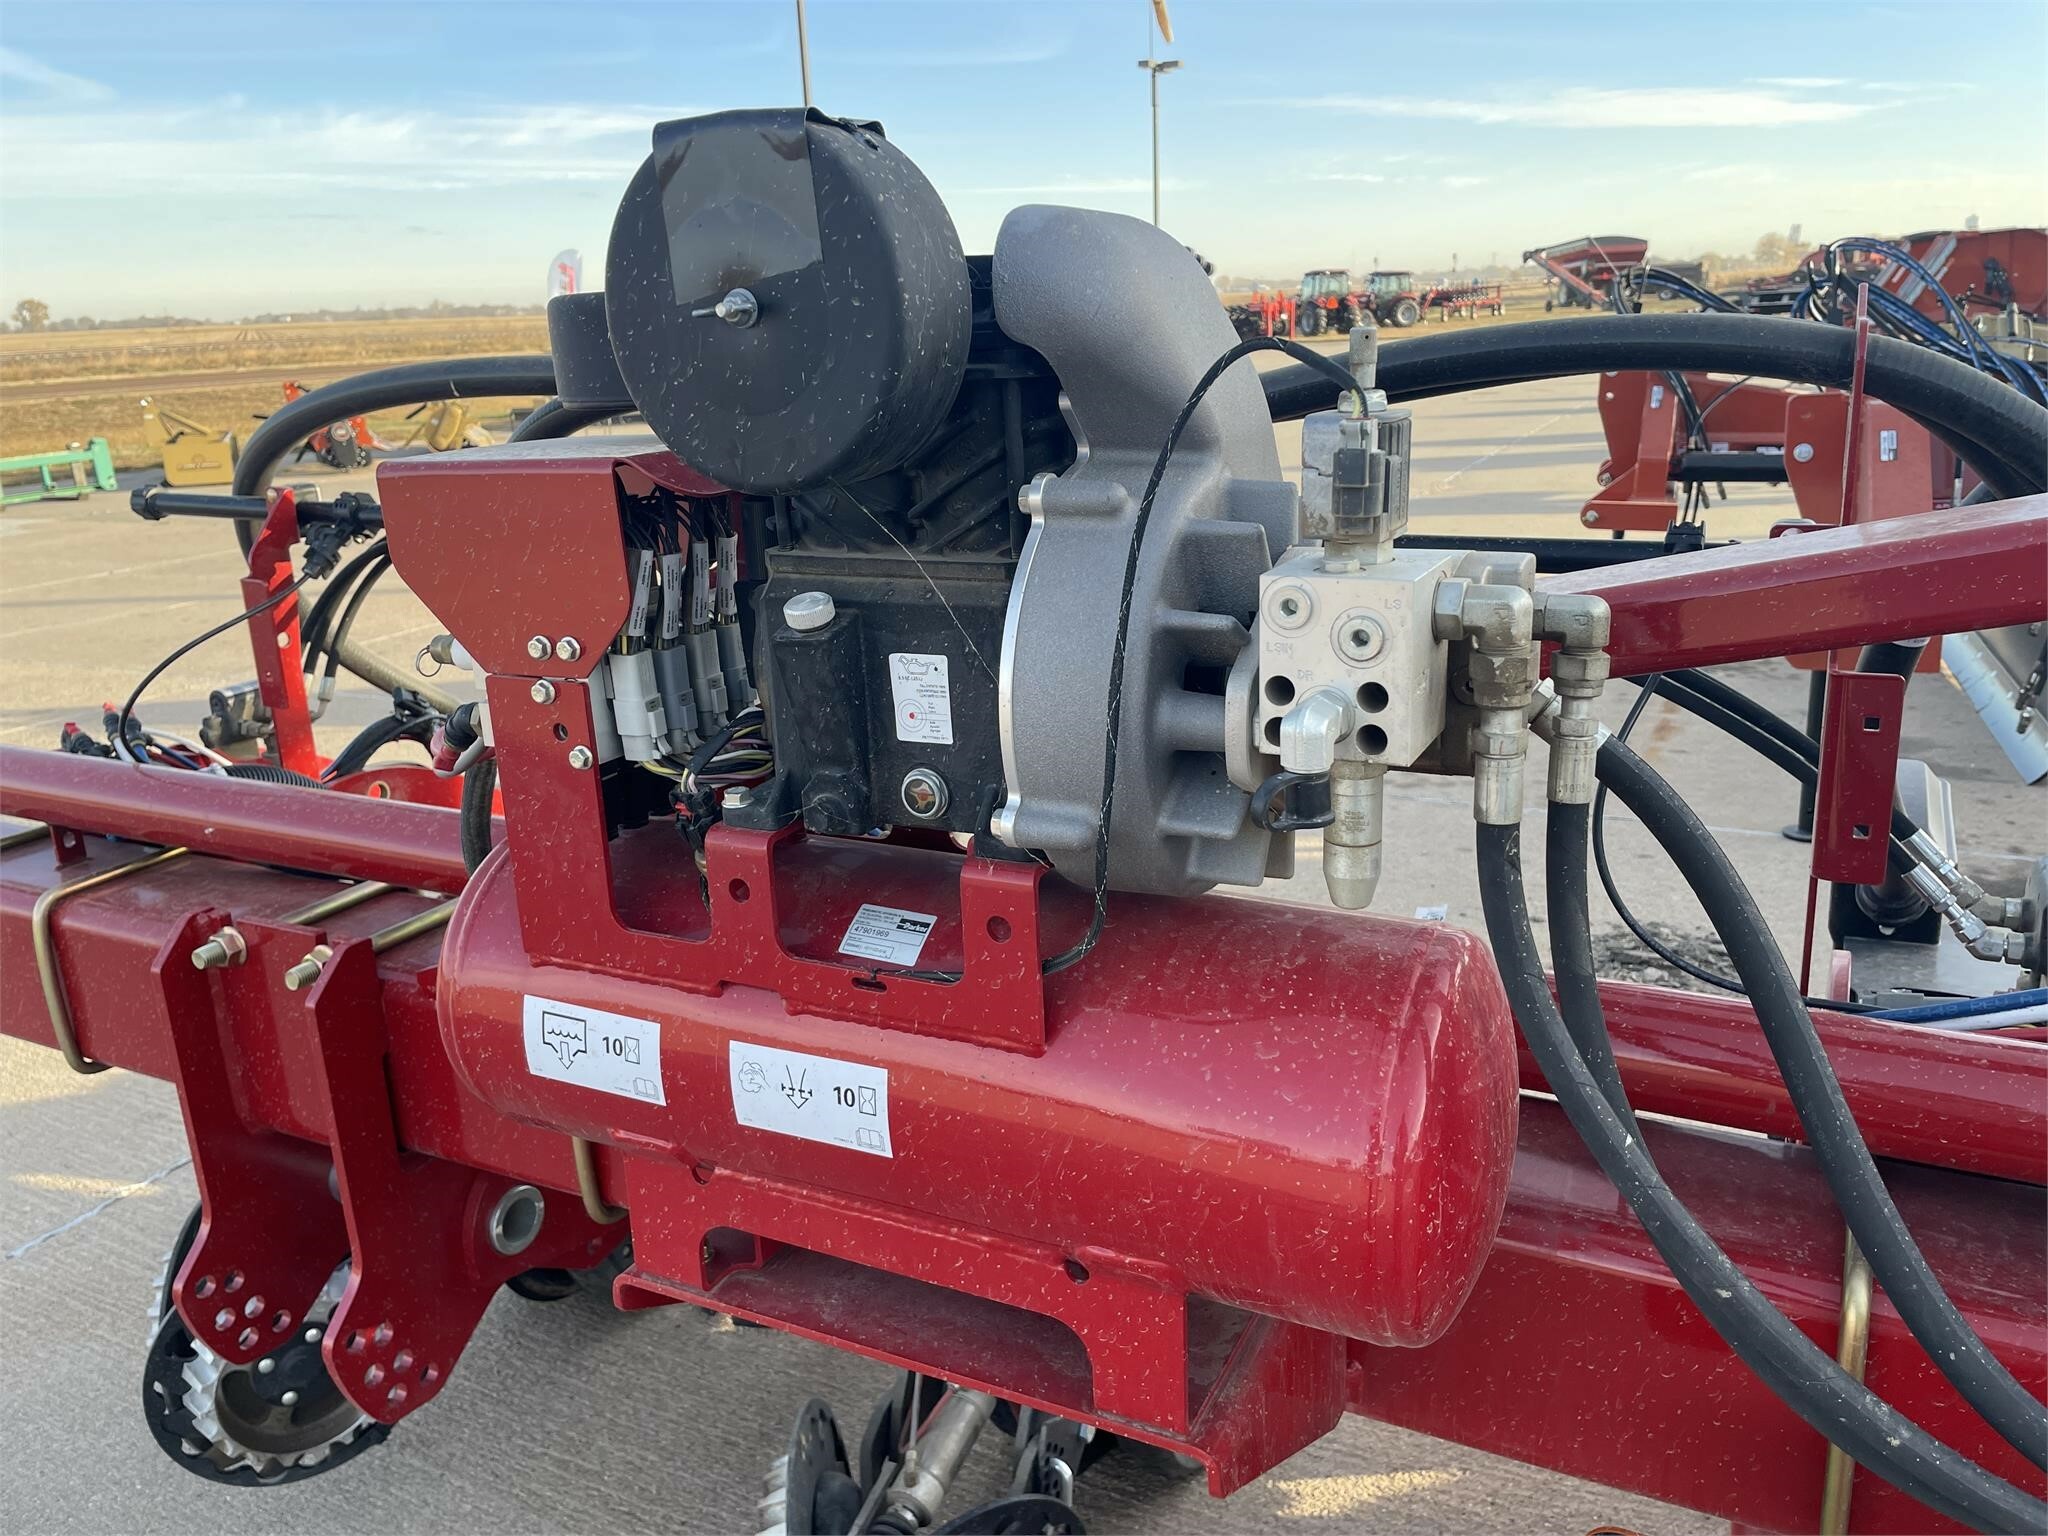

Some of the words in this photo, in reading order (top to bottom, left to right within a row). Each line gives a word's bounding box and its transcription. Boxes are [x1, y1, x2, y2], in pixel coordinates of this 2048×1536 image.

[854, 925, 890, 938] 47901969
[901, 922, 928, 933] Parker
[602, 1036, 623, 1057] 10
[833, 1086, 856, 1108] 10
